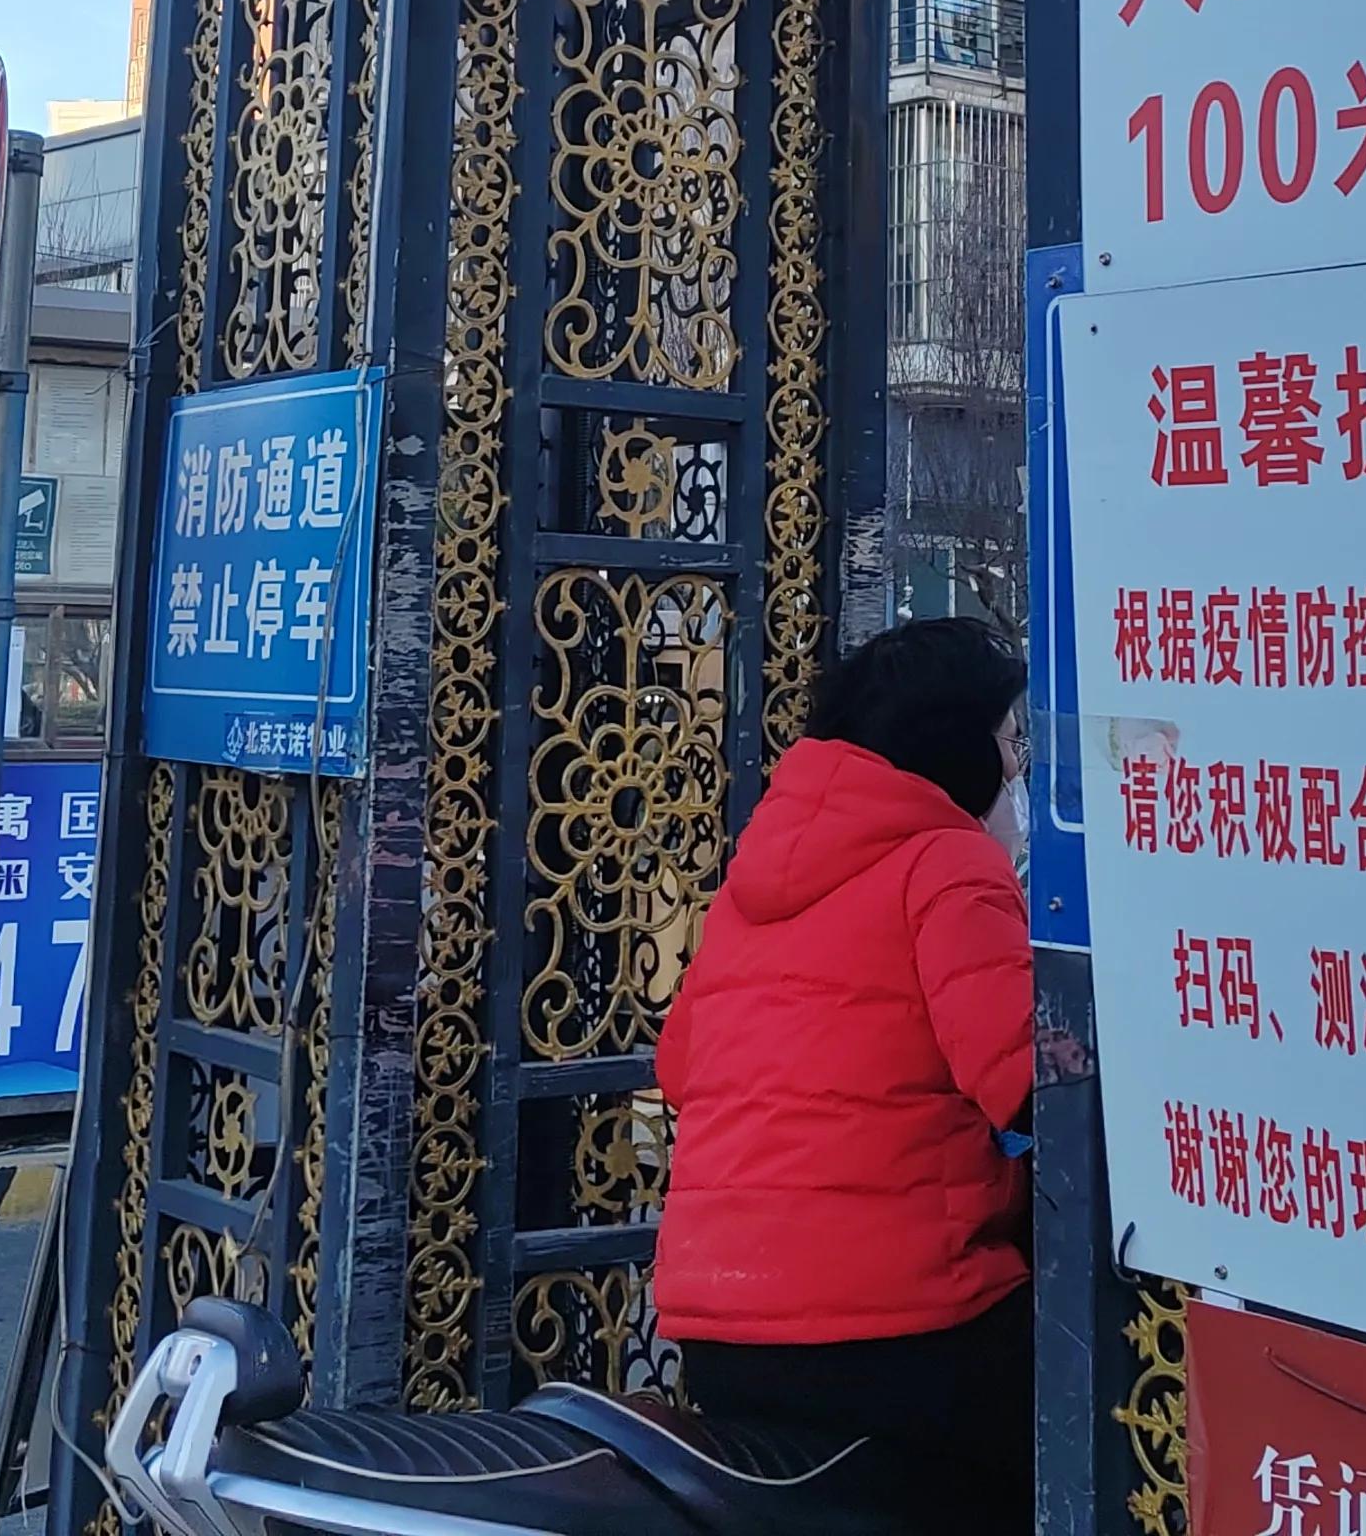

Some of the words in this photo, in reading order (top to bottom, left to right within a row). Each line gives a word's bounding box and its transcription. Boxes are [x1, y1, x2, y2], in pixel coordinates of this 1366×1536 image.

[175, 428, 348, 538] 消防通道
[167, 556, 335, 661] 禁止停车
[244, 720, 347, 759] 北京天诺物业
